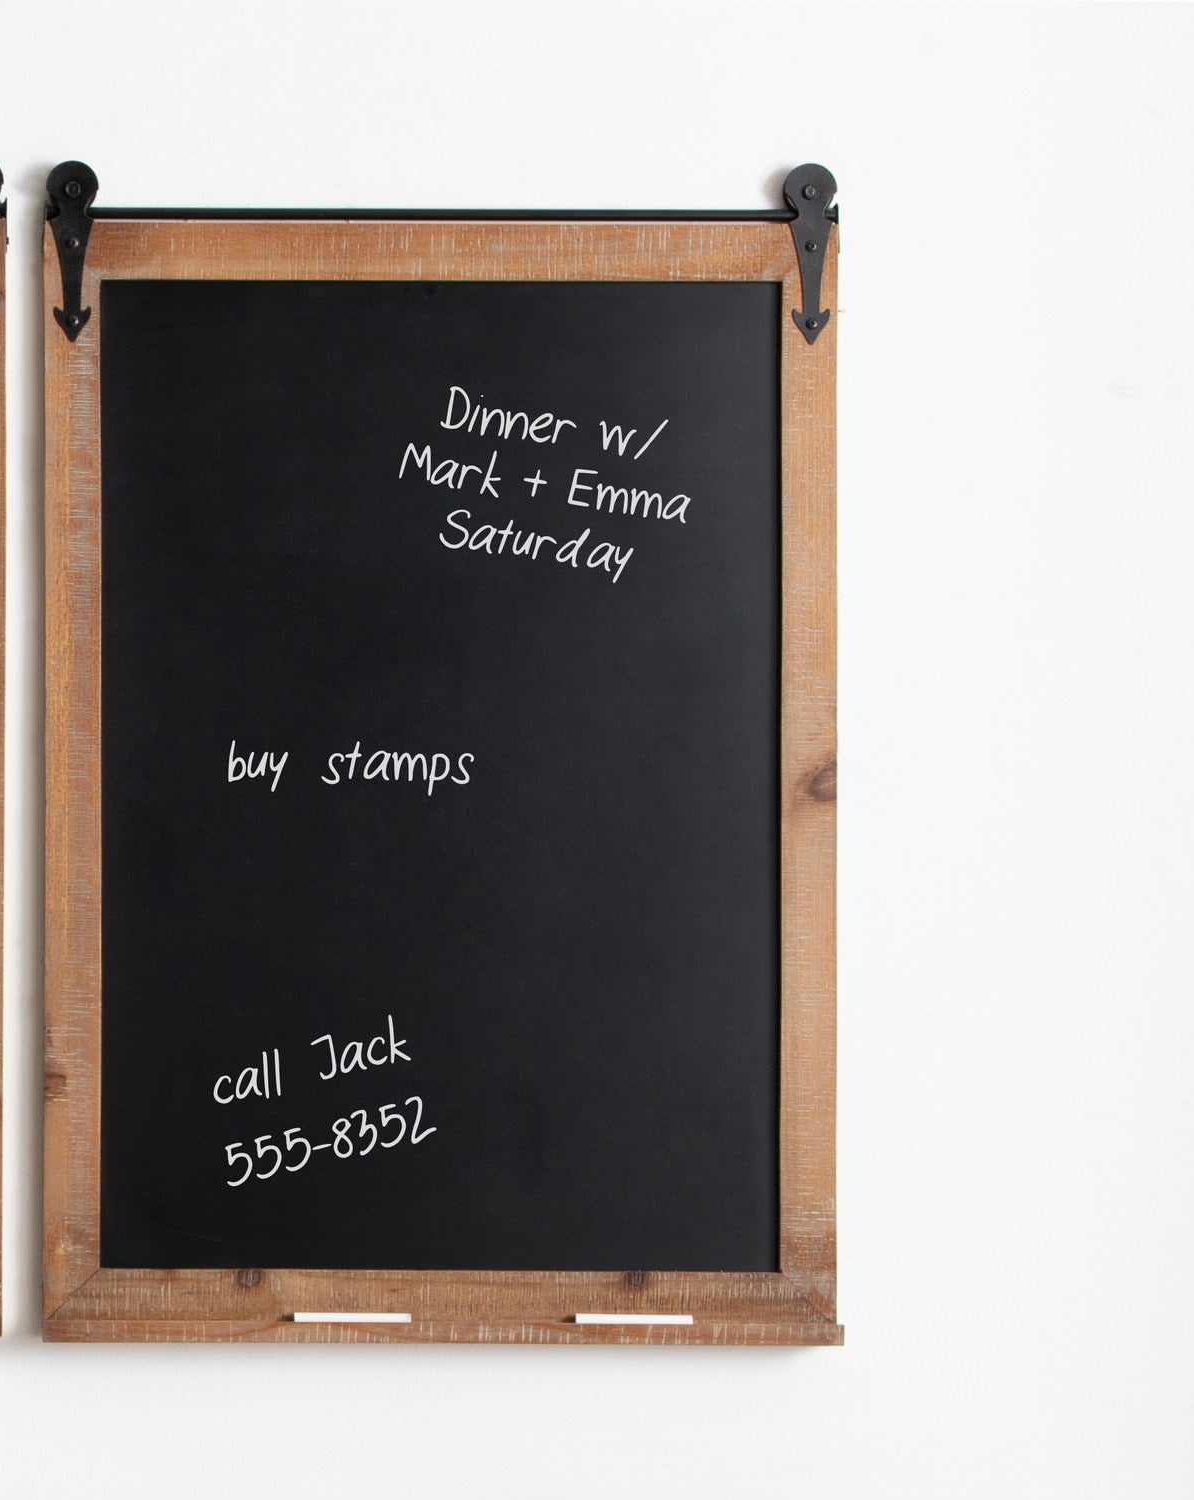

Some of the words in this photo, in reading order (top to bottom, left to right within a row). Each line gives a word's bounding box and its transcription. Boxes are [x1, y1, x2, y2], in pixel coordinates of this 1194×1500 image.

[440, 385, 577, 444] Dinner
[399, 442, 502, 499] Mark
[523, 469, 548, 498] +
[567, 468, 692, 524] Emma
[439, 509, 634, 584] Saturday
[227, 739, 289, 793] buy
[321, 740, 475, 797] stamps
[213, 1047, 282, 1105] call
[310, 1014, 412, 1080] Jack
[224, 1095, 437, 1187] 555-8352
